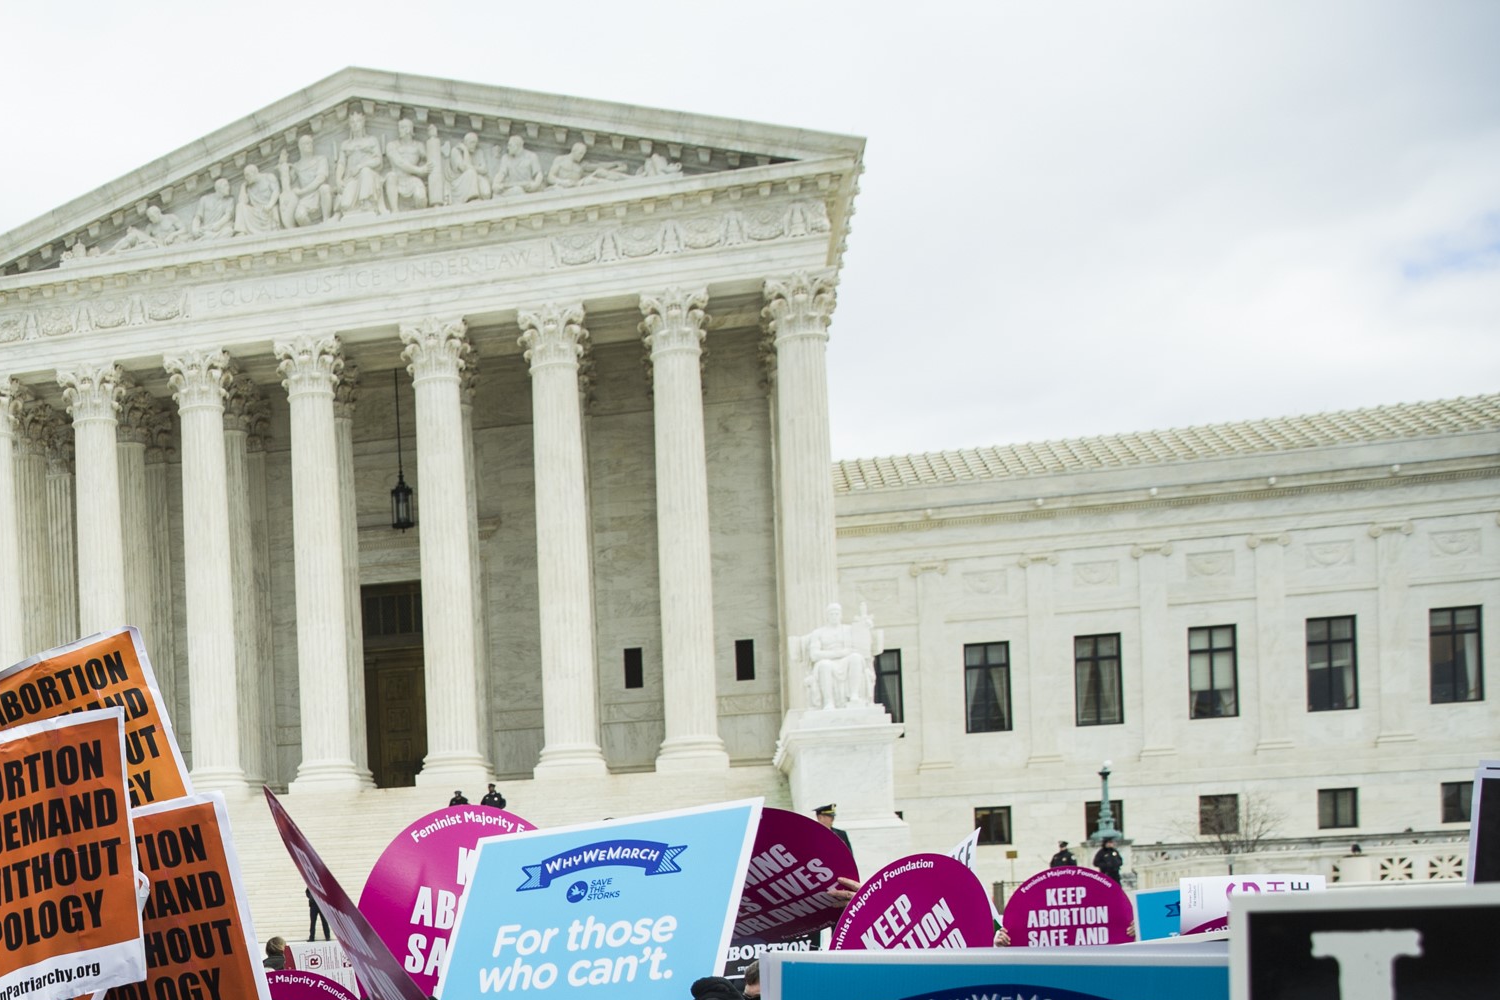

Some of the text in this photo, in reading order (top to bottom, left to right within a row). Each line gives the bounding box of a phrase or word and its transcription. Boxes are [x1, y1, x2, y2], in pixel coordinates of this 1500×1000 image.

[207, 248, 533, 309] EQUAL JUSTICE UNDER LAW
[411, 813, 462, 843] Feminist
[464, 811, 514, 833] Majority
[587, 890, 621, 901] STORKS
[590, 886, 606, 894] THE
[591, 878, 613, 886] SAVE
[757, 858, 834, 905] LIVES
[851, 879, 883, 918] Majority
[883, 859, 934, 882] Foundation
[1020, 869, 1112, 893] Feminist Majority Foundation
[1045, 887, 1086, 906] KEEP
[410, 886, 460, 931] AB
[860, 894, 912, 950] KEEP
[892, 896, 956, 950] TION
[1026, 906, 1109, 928] ABORTION
[492, 915, 678, 958] For those
[1027, 927, 1109, 948] SAFE AND
[276, 974, 316, 988] Majority
[479, 957, 559, 993] who
